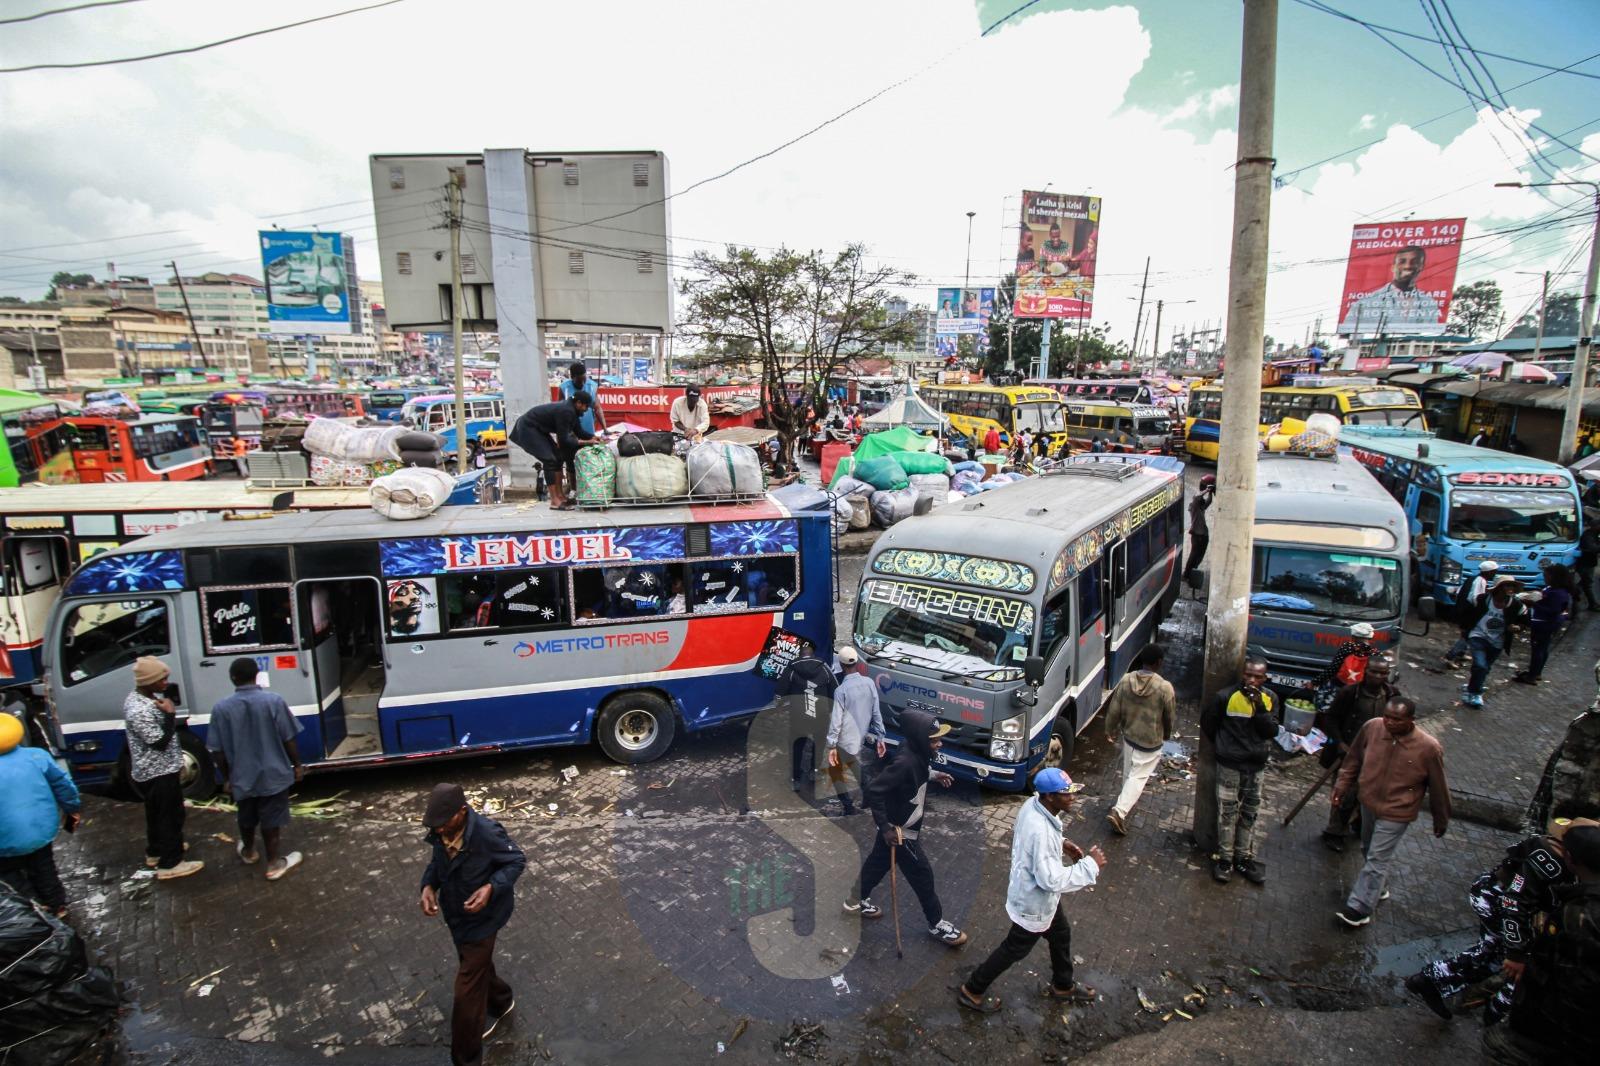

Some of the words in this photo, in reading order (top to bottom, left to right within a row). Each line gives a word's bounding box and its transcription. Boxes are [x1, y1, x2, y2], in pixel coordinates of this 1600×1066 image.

[1036, 198, 1057, 208] Ladha
[1028, 206, 1036, 215] ni
[1036, 208, 1063, 218] sherehe
[1063, 211, 1088, 220] mezani
[1381, 226, 1424, 239] OVER
[1431, 224, 1459, 236] 140
[1356, 240, 1404, 249] MEDICAL
[1407, 237, 1457, 247] CENTRES
[1378, 290, 1447, 299] HEALTHCARE
[1400, 309, 1443, 317] KENYA
[629, 394, 670, 406] KIOSK
[1352, 447, 1386, 468] ONIA
[1456, 472, 1563, 486] SONIA
[442, 533, 632, 570] LEMUEL
[868, 579, 1023, 627] BITCOIN
[213, 602, 251, 624] Pablo
[231, 616, 257, 637] 254
[535, 630, 669, 653] METROTRANS
[775, 640, 800, 656] MUSI
[766, 658, 788, 675] BETT
[1527, 848, 1562, 879] 8
